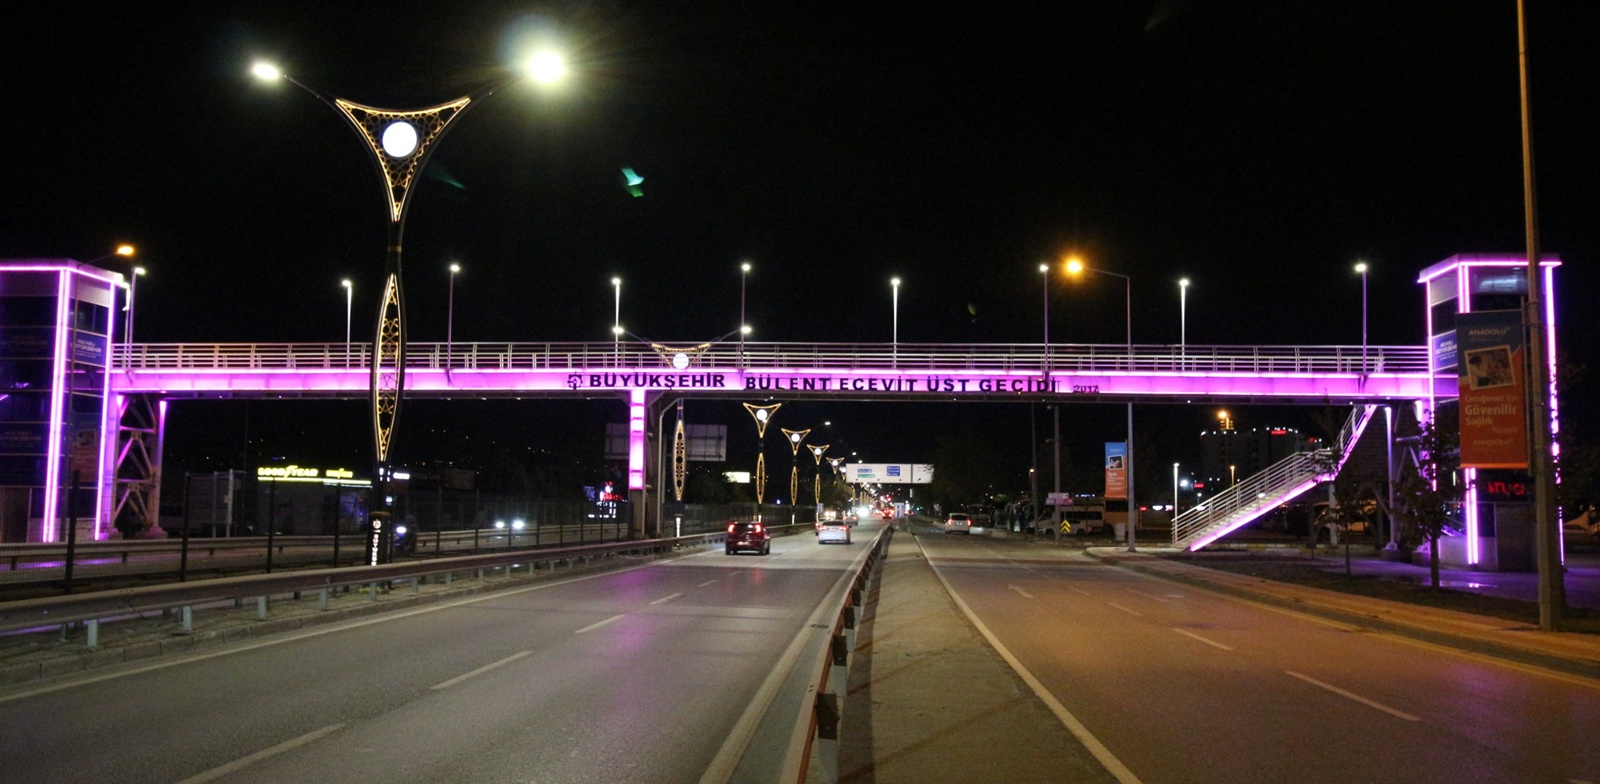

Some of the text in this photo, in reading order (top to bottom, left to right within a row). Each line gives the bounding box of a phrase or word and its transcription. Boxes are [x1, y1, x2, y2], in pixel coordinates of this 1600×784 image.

[1469, 327, 1507, 337] ANADOLU
[589, 372, 726, 390] BÜYÜKŞEHİR
[745, 374, 831, 390] BÜLENT
[839, 376, 918, 392] ECEVİT
[926, 376, 970, 392] ÜST
[1073, 385, 1100, 393] 2017
[1464, 404, 1518, 415] Güvenilir
[1465, 416, 1493, 428] Sağlık
[257, 465, 319, 478] GOODYEAR
